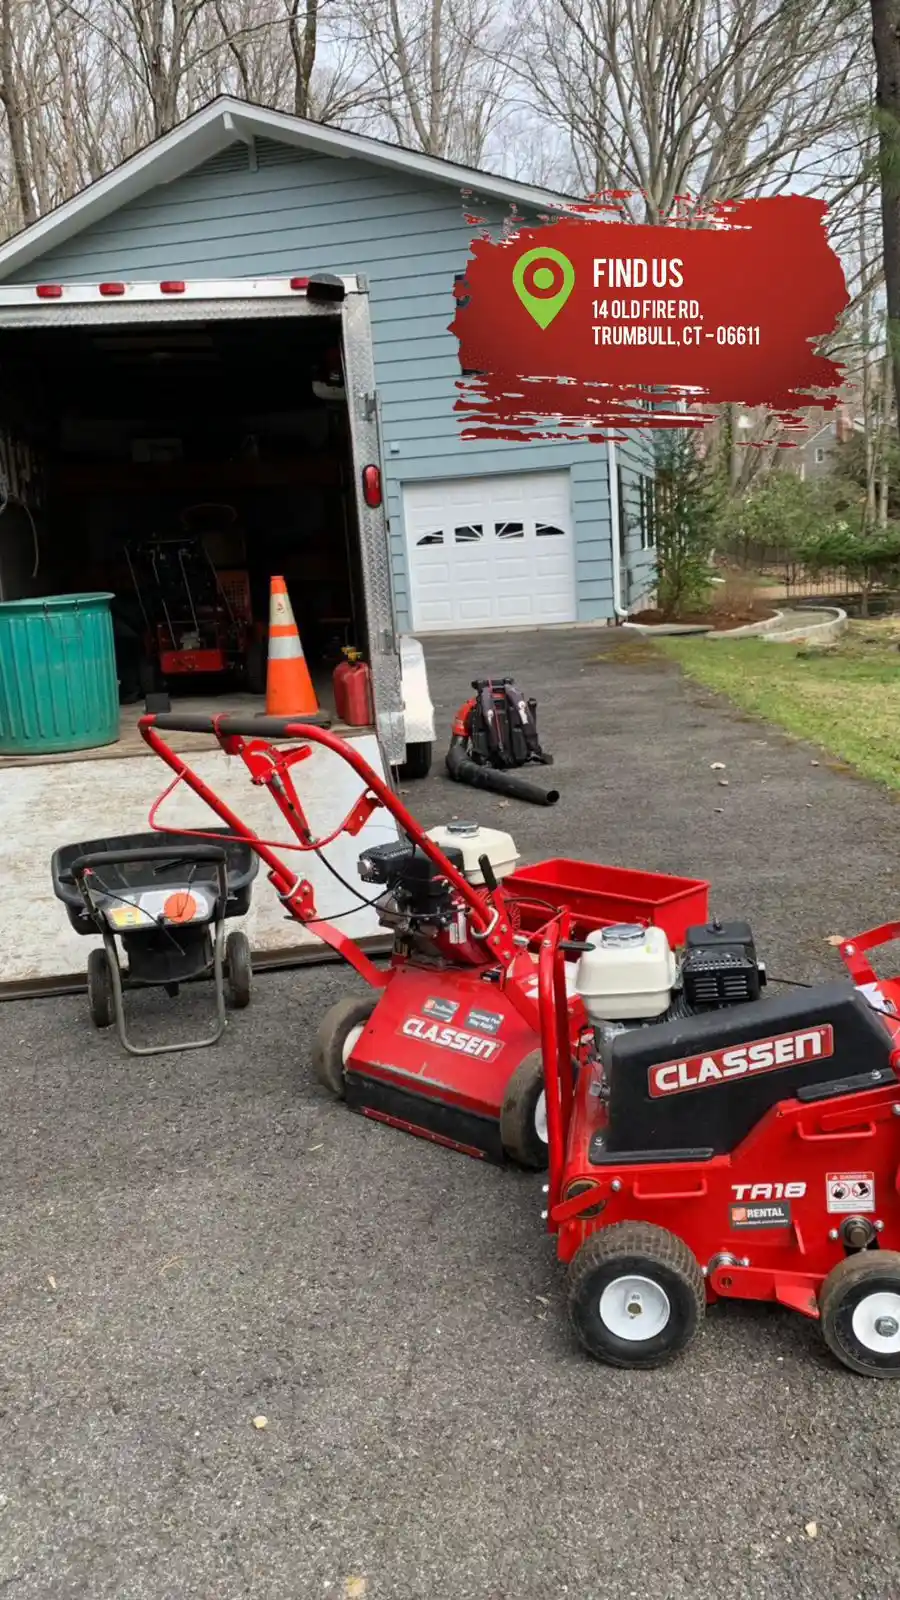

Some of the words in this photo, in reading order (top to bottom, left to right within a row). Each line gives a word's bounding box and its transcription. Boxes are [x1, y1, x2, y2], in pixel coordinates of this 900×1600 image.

[402, 1018, 497, 1058] CLASSEN
[655, 1030, 824, 1092] CLASSEN
[731, 1182, 807, 1200] TA18
[746, 1206, 785, 1219] RENTAL
